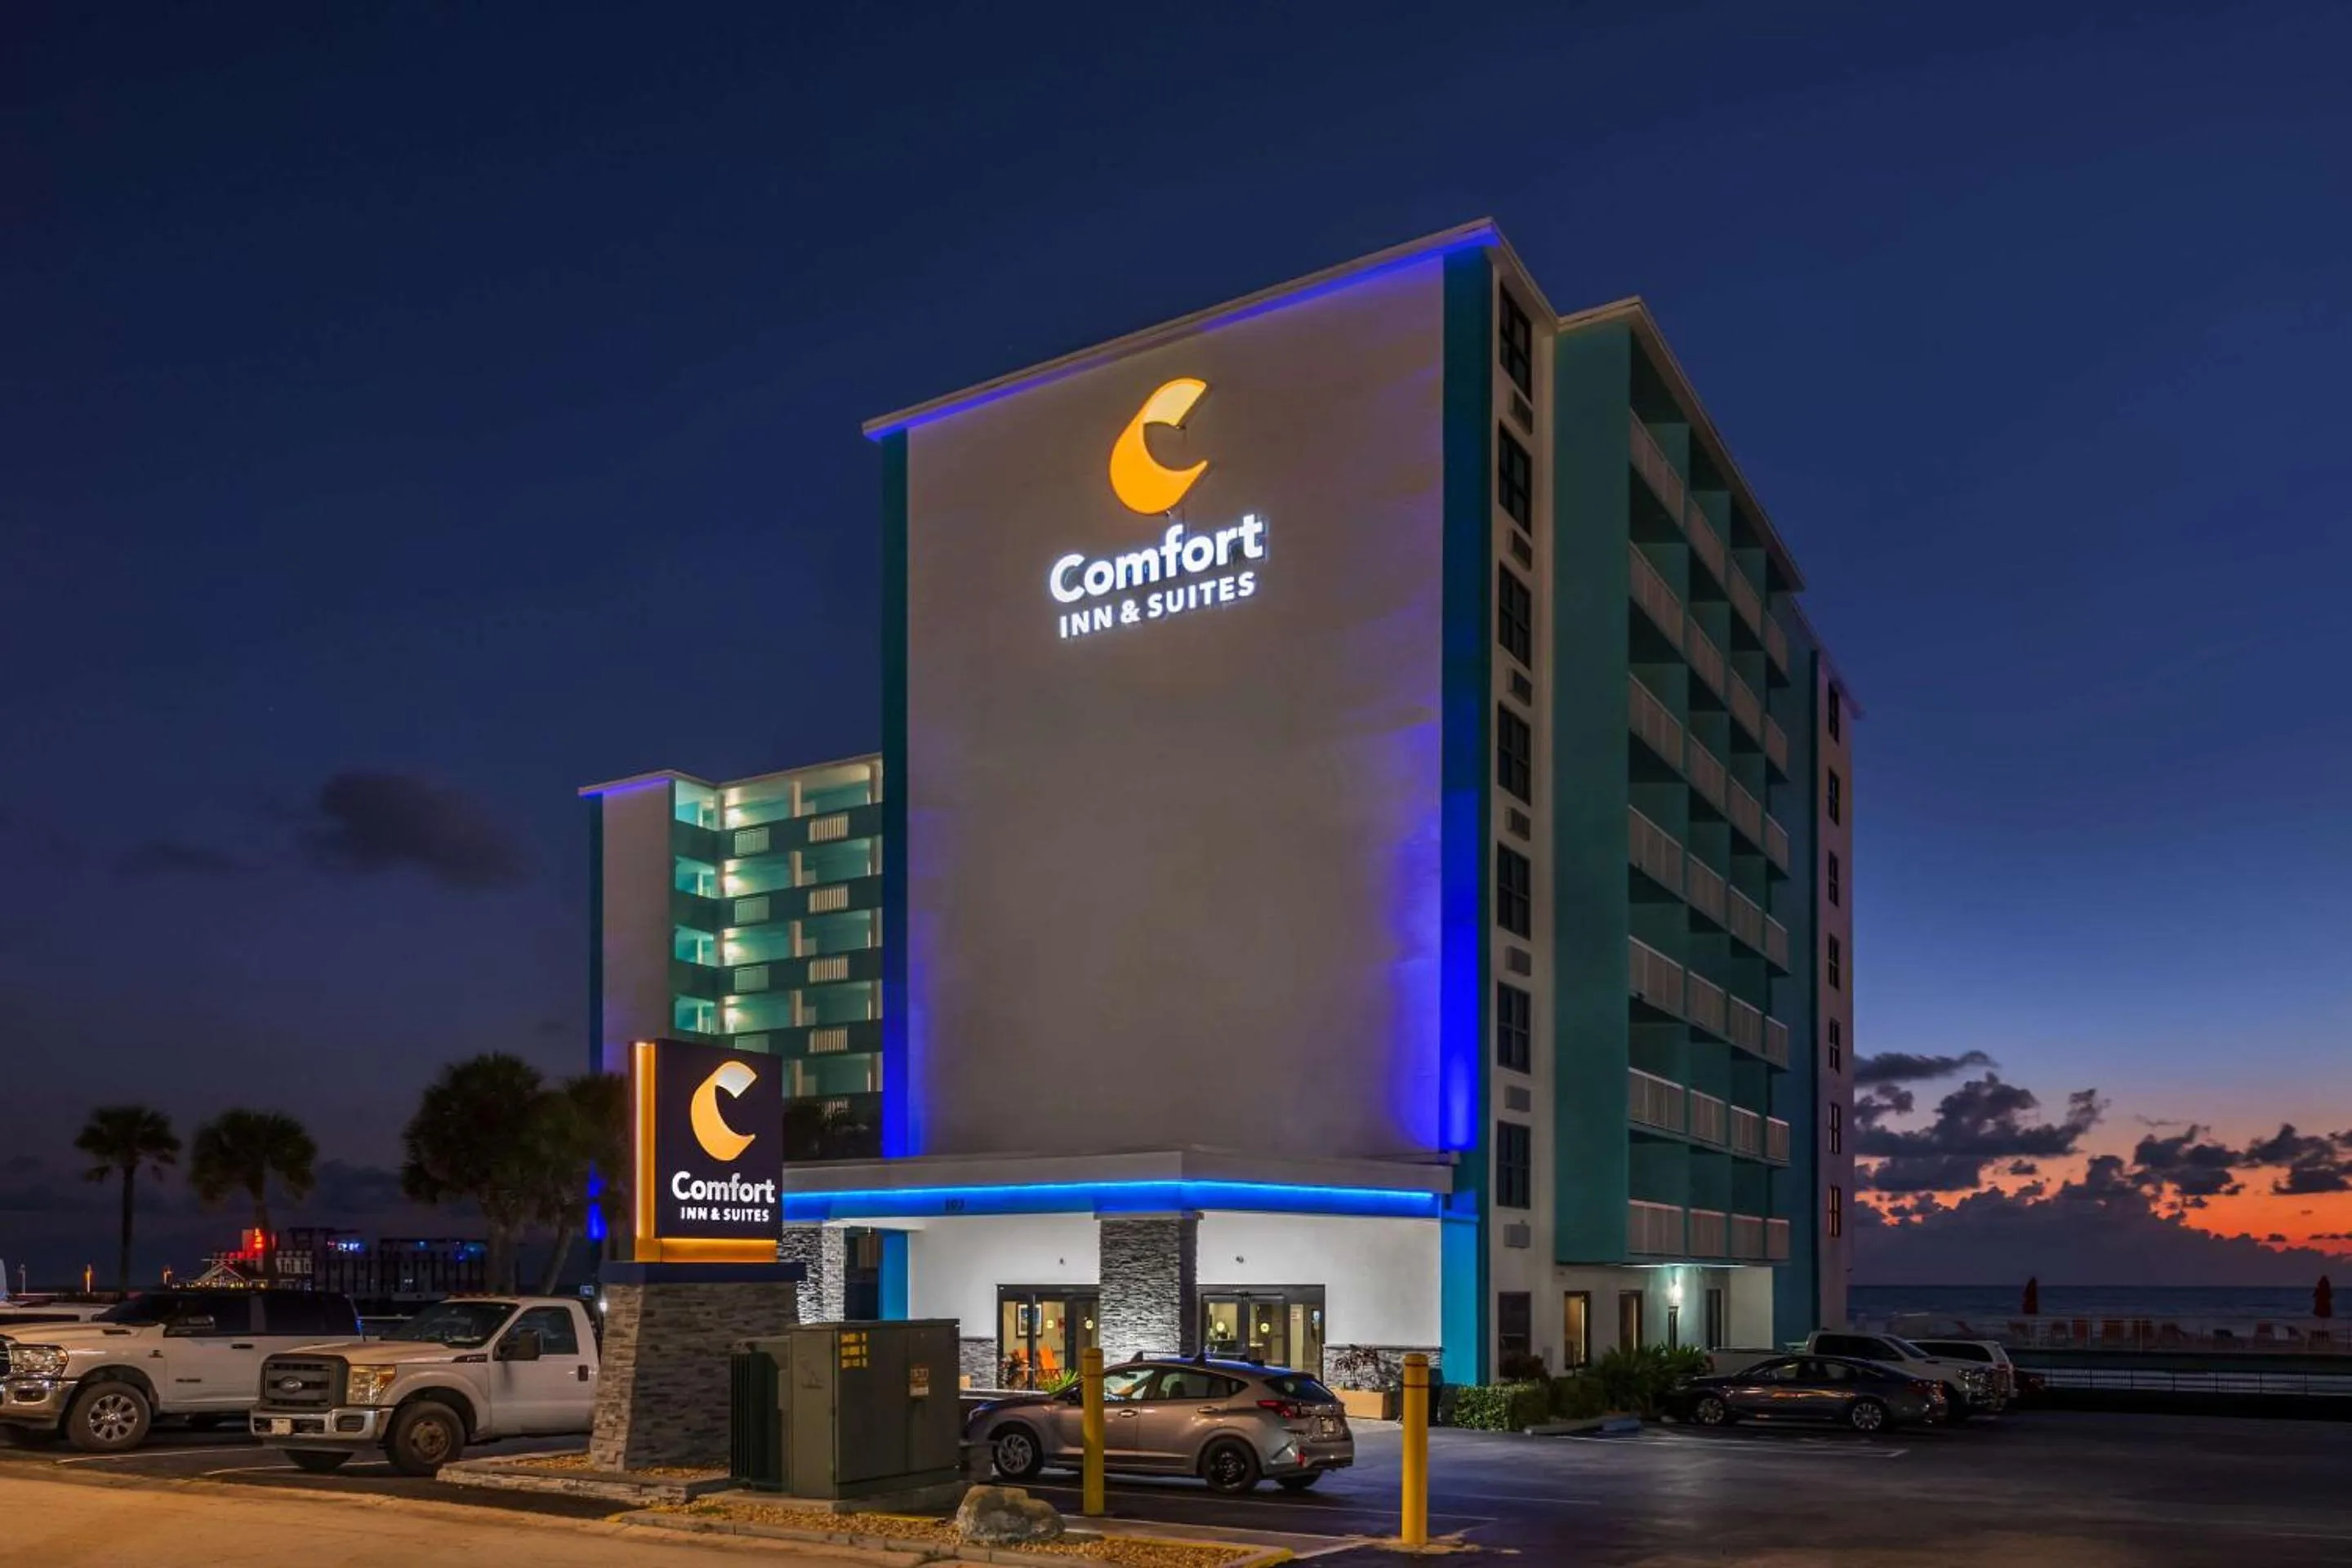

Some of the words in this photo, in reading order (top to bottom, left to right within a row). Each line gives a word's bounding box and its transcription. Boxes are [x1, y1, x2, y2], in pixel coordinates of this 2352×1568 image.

[1049, 514, 1263, 603] Comfort
[1059, 604, 1112, 639] INN
[1120, 599, 1141, 624] &
[1147, 571, 1255, 618] SUITES
[671, 1170, 775, 1204] Comfort
[680, 1206, 708, 1220] INN
[710, 1207, 720, 1221] &
[723, 1208, 769, 1223] SUITES
